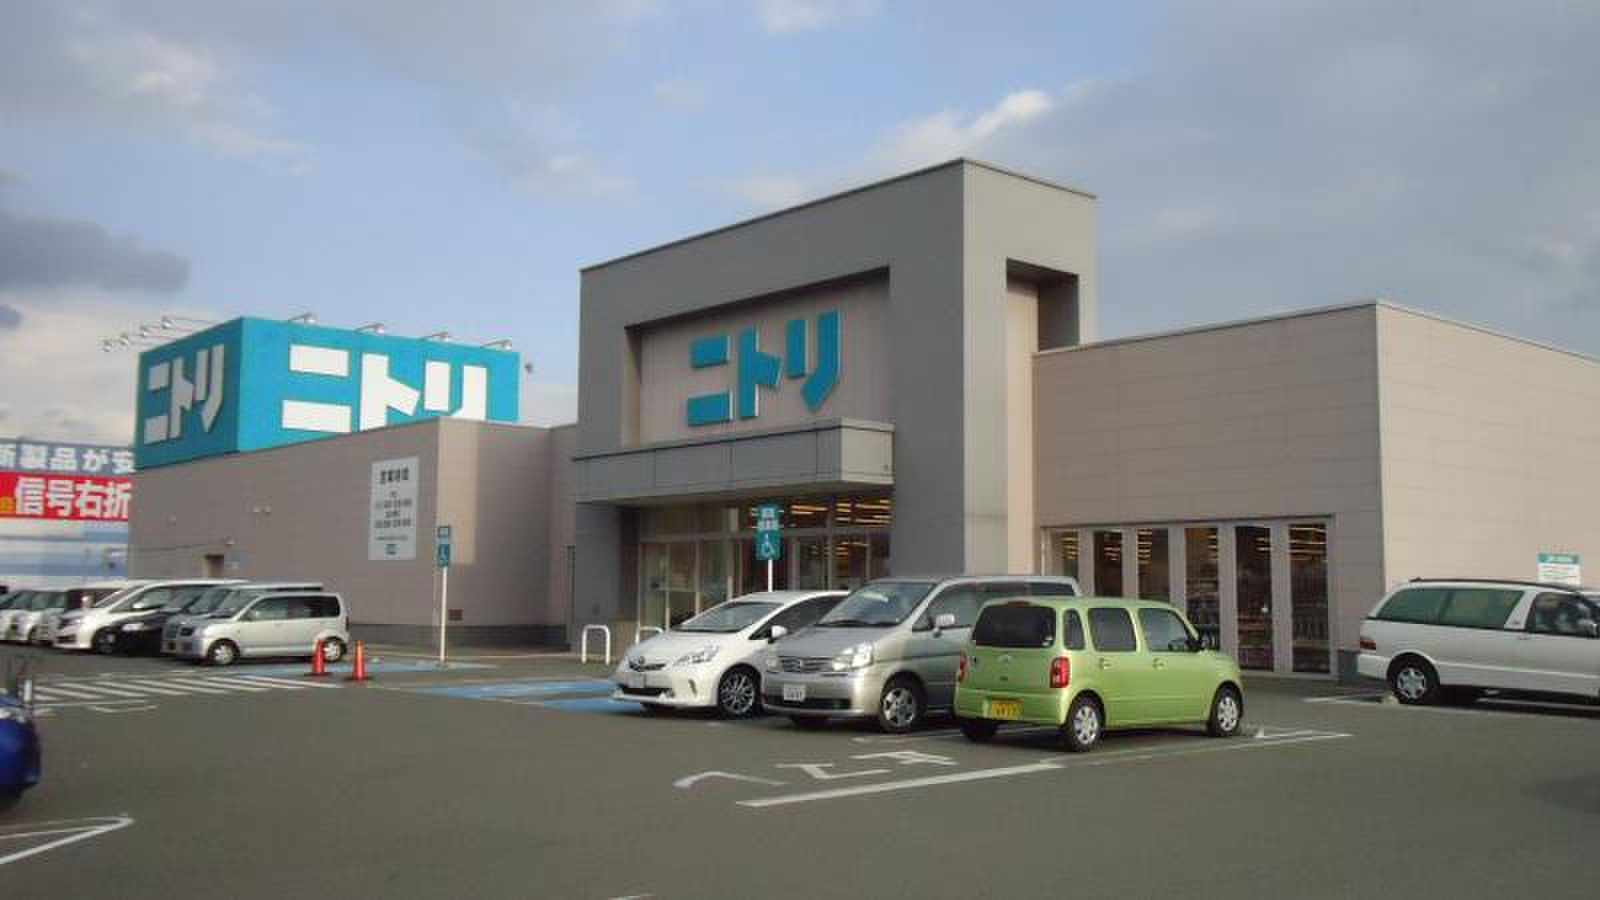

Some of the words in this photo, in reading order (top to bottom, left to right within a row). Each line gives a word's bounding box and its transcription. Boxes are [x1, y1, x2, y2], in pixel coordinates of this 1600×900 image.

[143, 343, 225, 445] ニトリ
[281, 344, 487, 433] ニトリ
[685, 310, 840, 427] ニトリ
[15, 476, 132, 519] 信号右折
